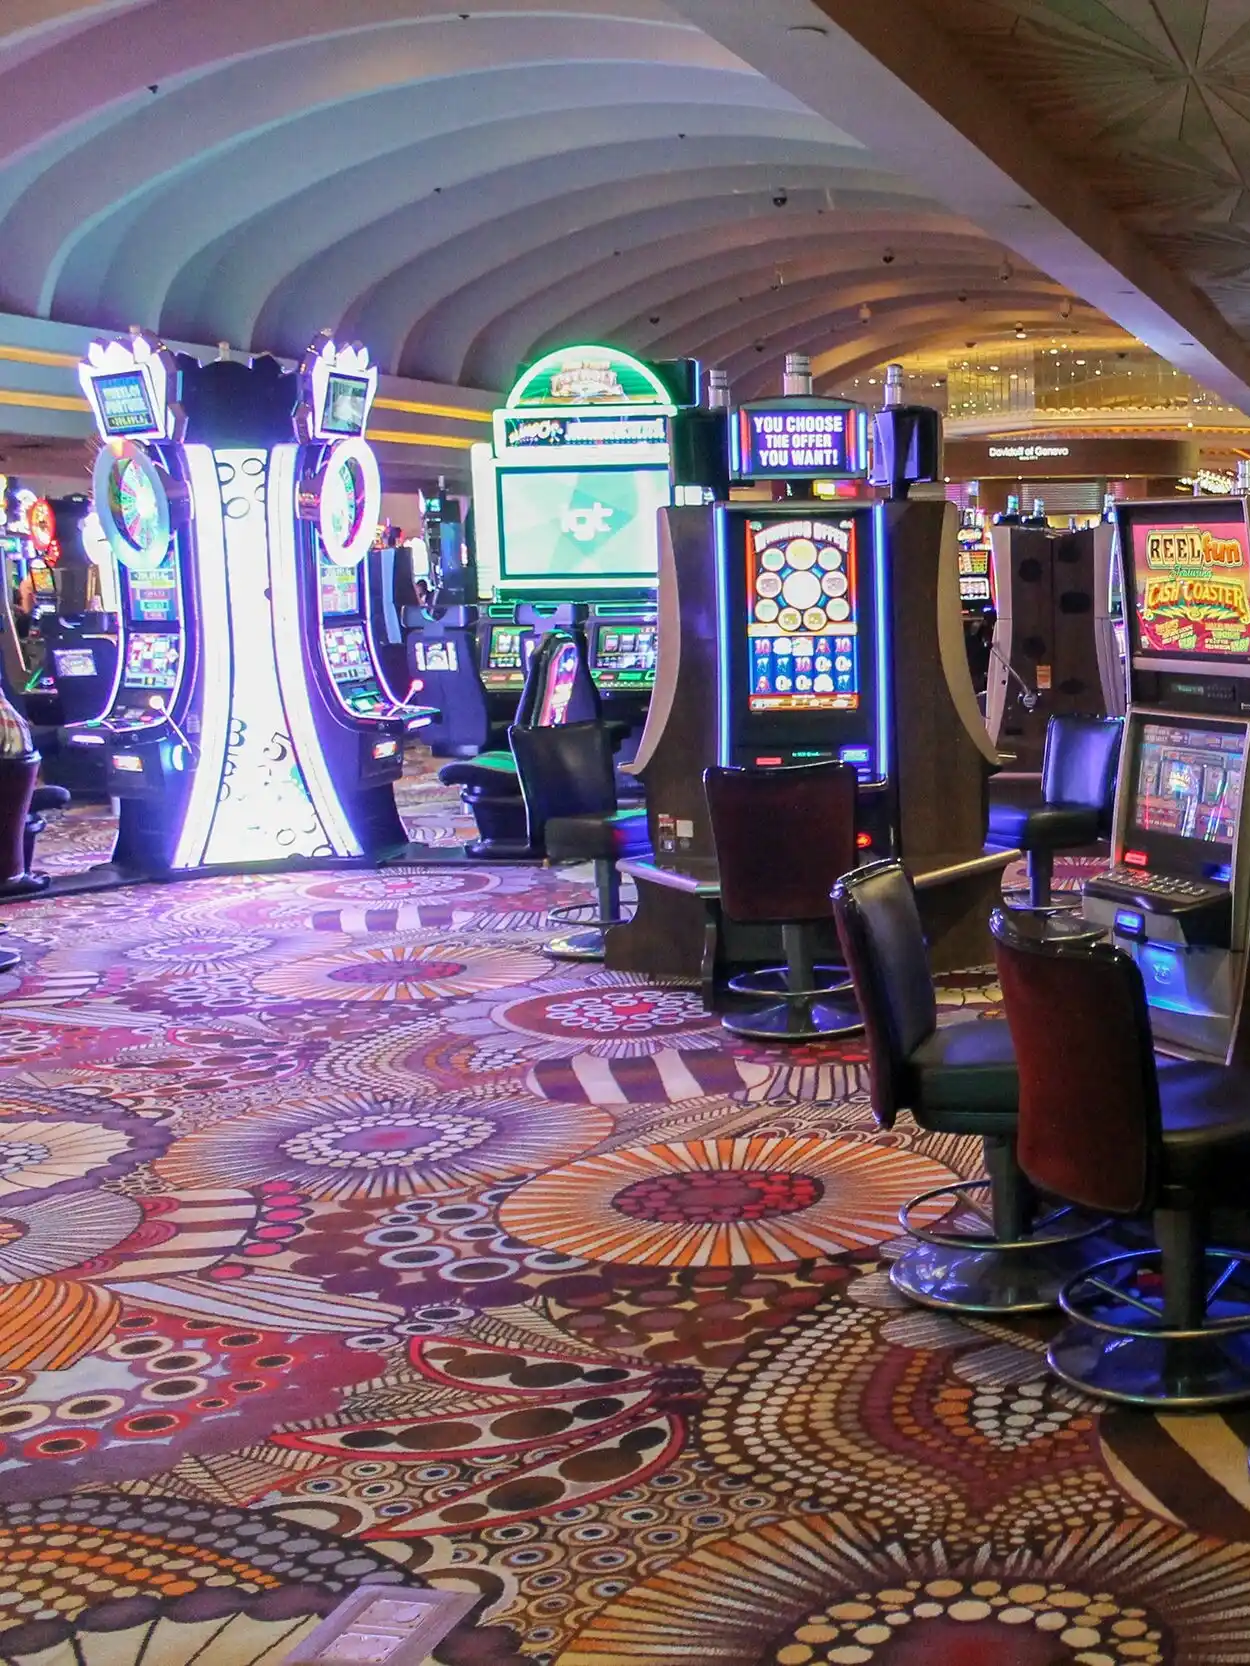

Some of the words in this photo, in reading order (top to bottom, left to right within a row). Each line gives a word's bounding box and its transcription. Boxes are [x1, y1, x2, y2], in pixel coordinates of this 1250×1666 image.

[753, 416, 783, 433] YOU
[786, 415, 843, 433] CHOOSE
[765, 434, 790, 448] THE
[791, 434, 832, 448] OFFER
[759, 449, 789, 466] YOU
[791, 449, 838, 466] WANT!
[989, 446, 1024, 457] Davidoff
[1034, 446, 1069, 456] Geneva
[1150, 538, 1201, 559] REEL
[1201, 532, 1241, 564] fun
[1149, 584, 1180, 608] CASH
[1183, 580, 1244, 610] COASTER
